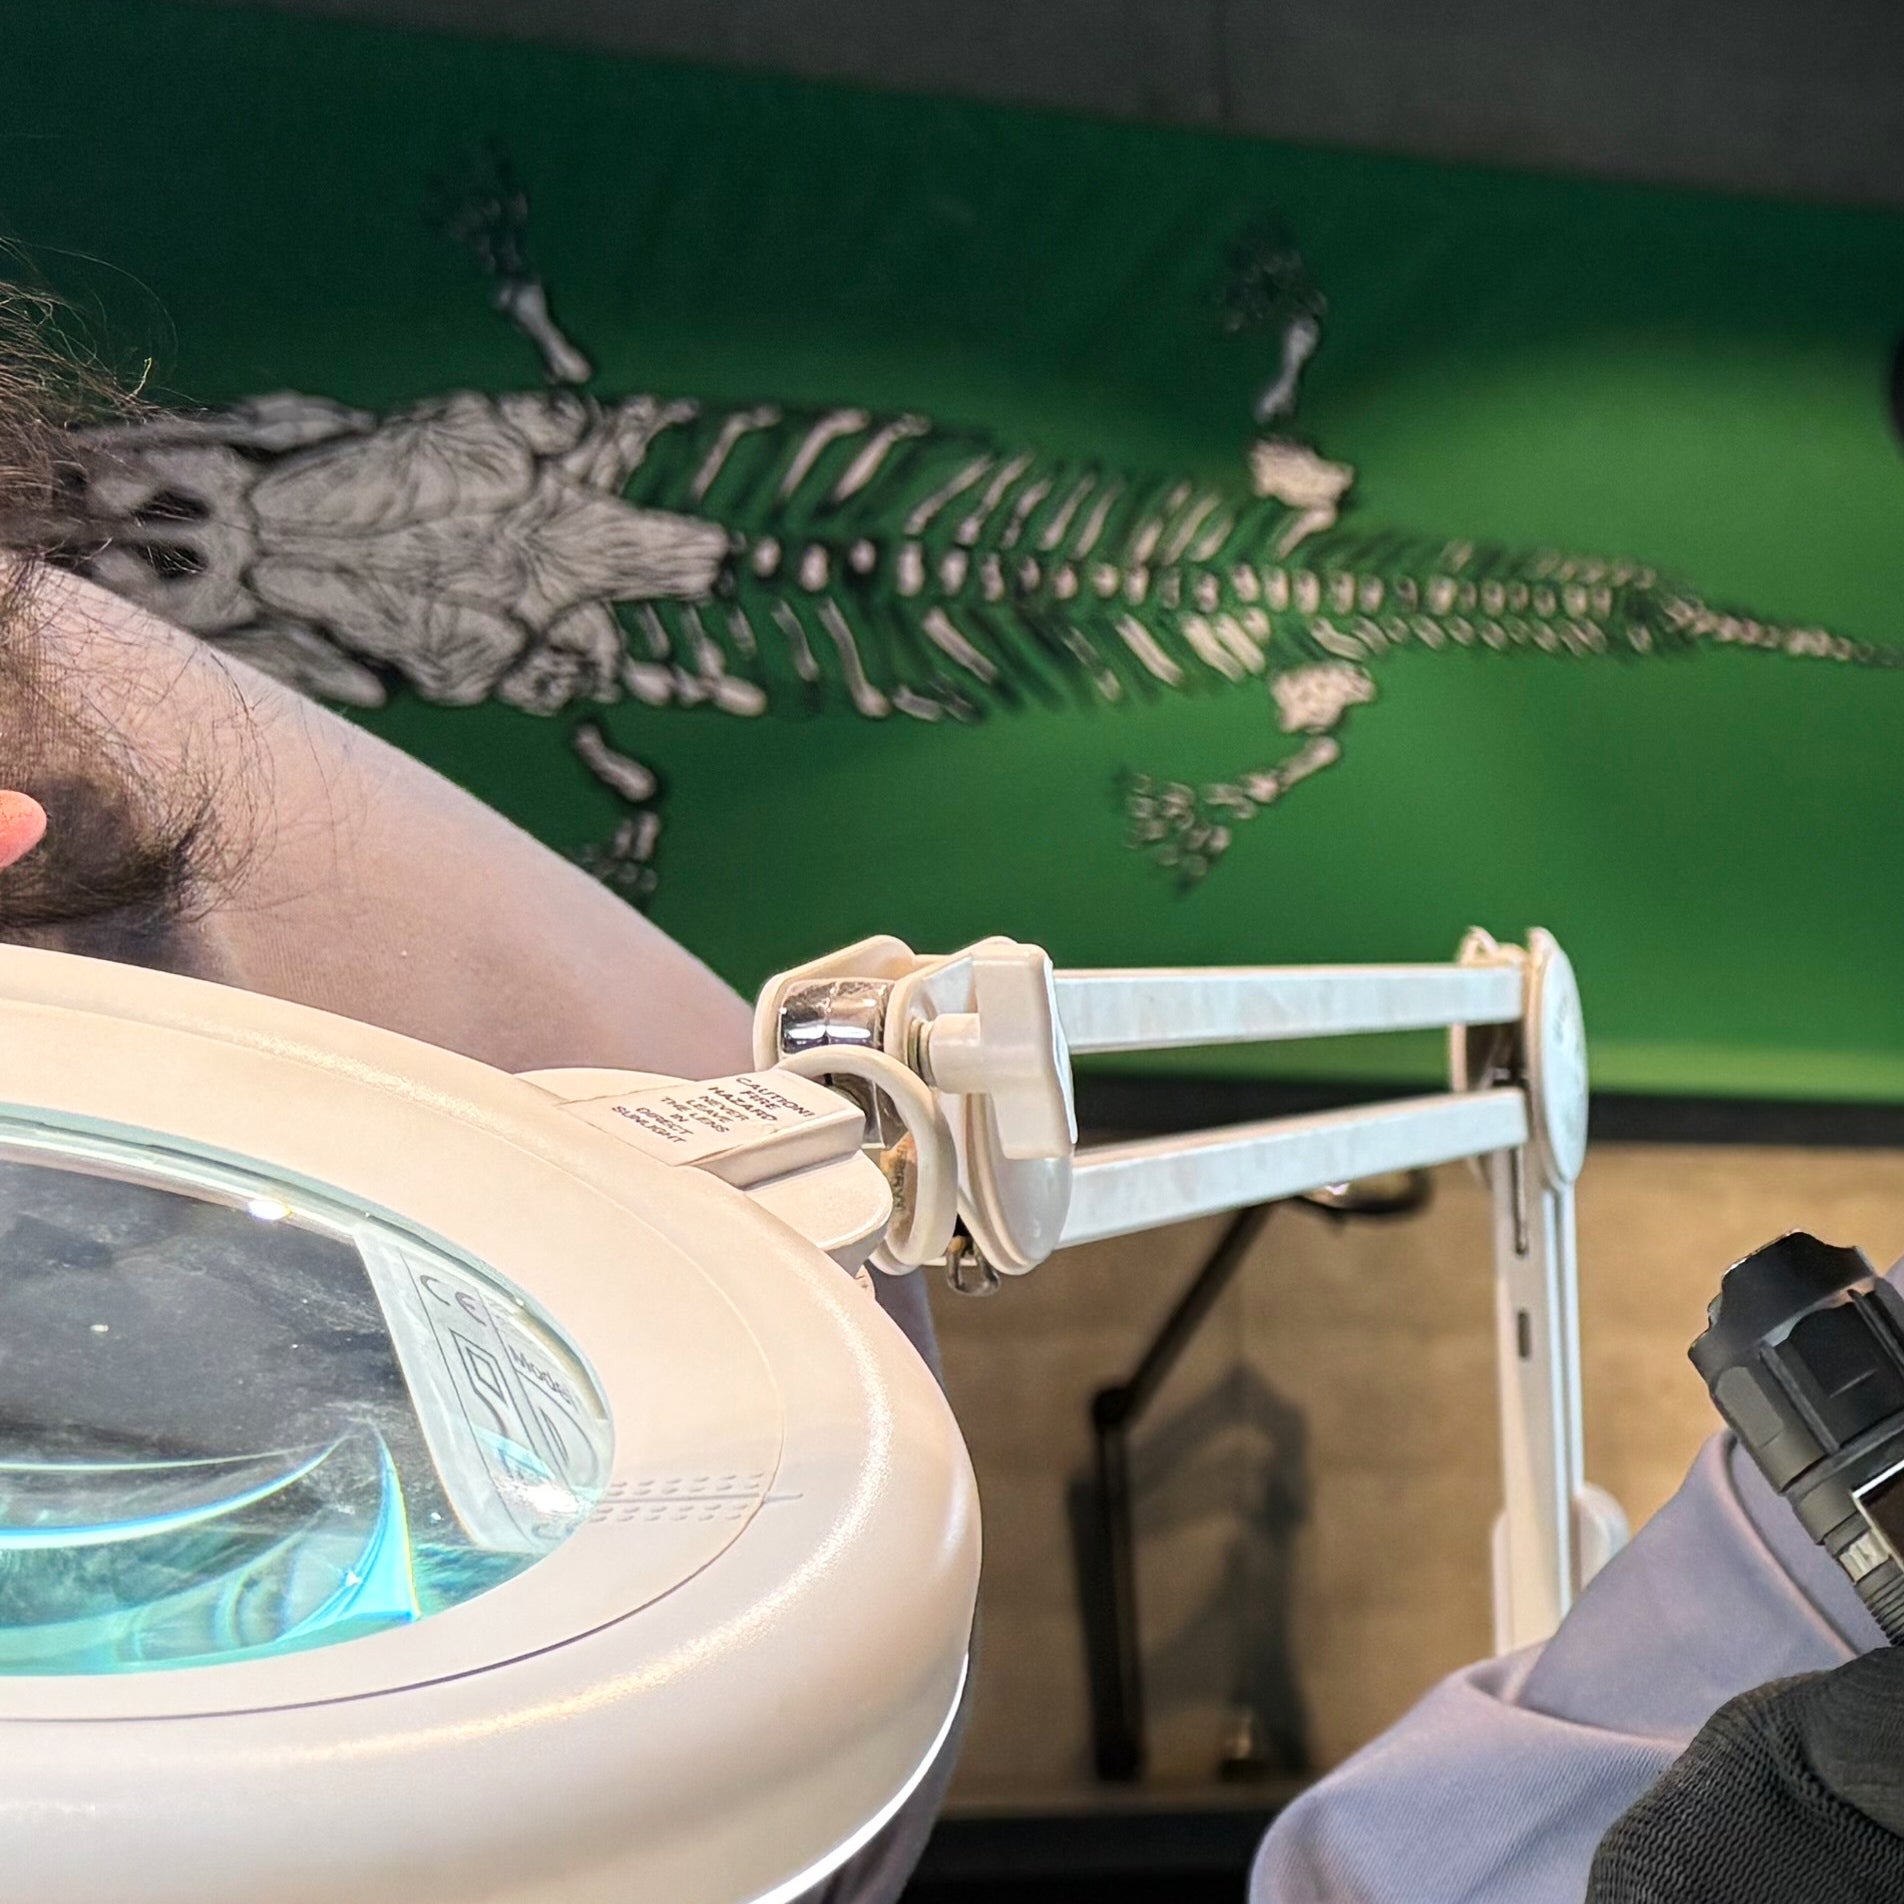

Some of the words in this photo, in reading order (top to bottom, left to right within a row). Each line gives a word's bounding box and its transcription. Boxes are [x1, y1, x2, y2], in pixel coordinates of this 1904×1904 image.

[686, 1099, 734, 1123] LEAVE
[699, 1095, 750, 1121] NEVER
[708, 1086, 778, 1121] HAZARD
[736, 1077, 815, 1117] CAUTION!
[739, 1090, 781, 1110] FIRE
[612, 1106, 687, 1142] SUNLIGHT
[636, 1107, 694, 1135] DIRECT
[661, 1097, 692, 1111] THE
[689, 1113, 730, 1133] LENS
[670, 1113, 689, 1122] IN
[419, 1274, 488, 1327] CE
